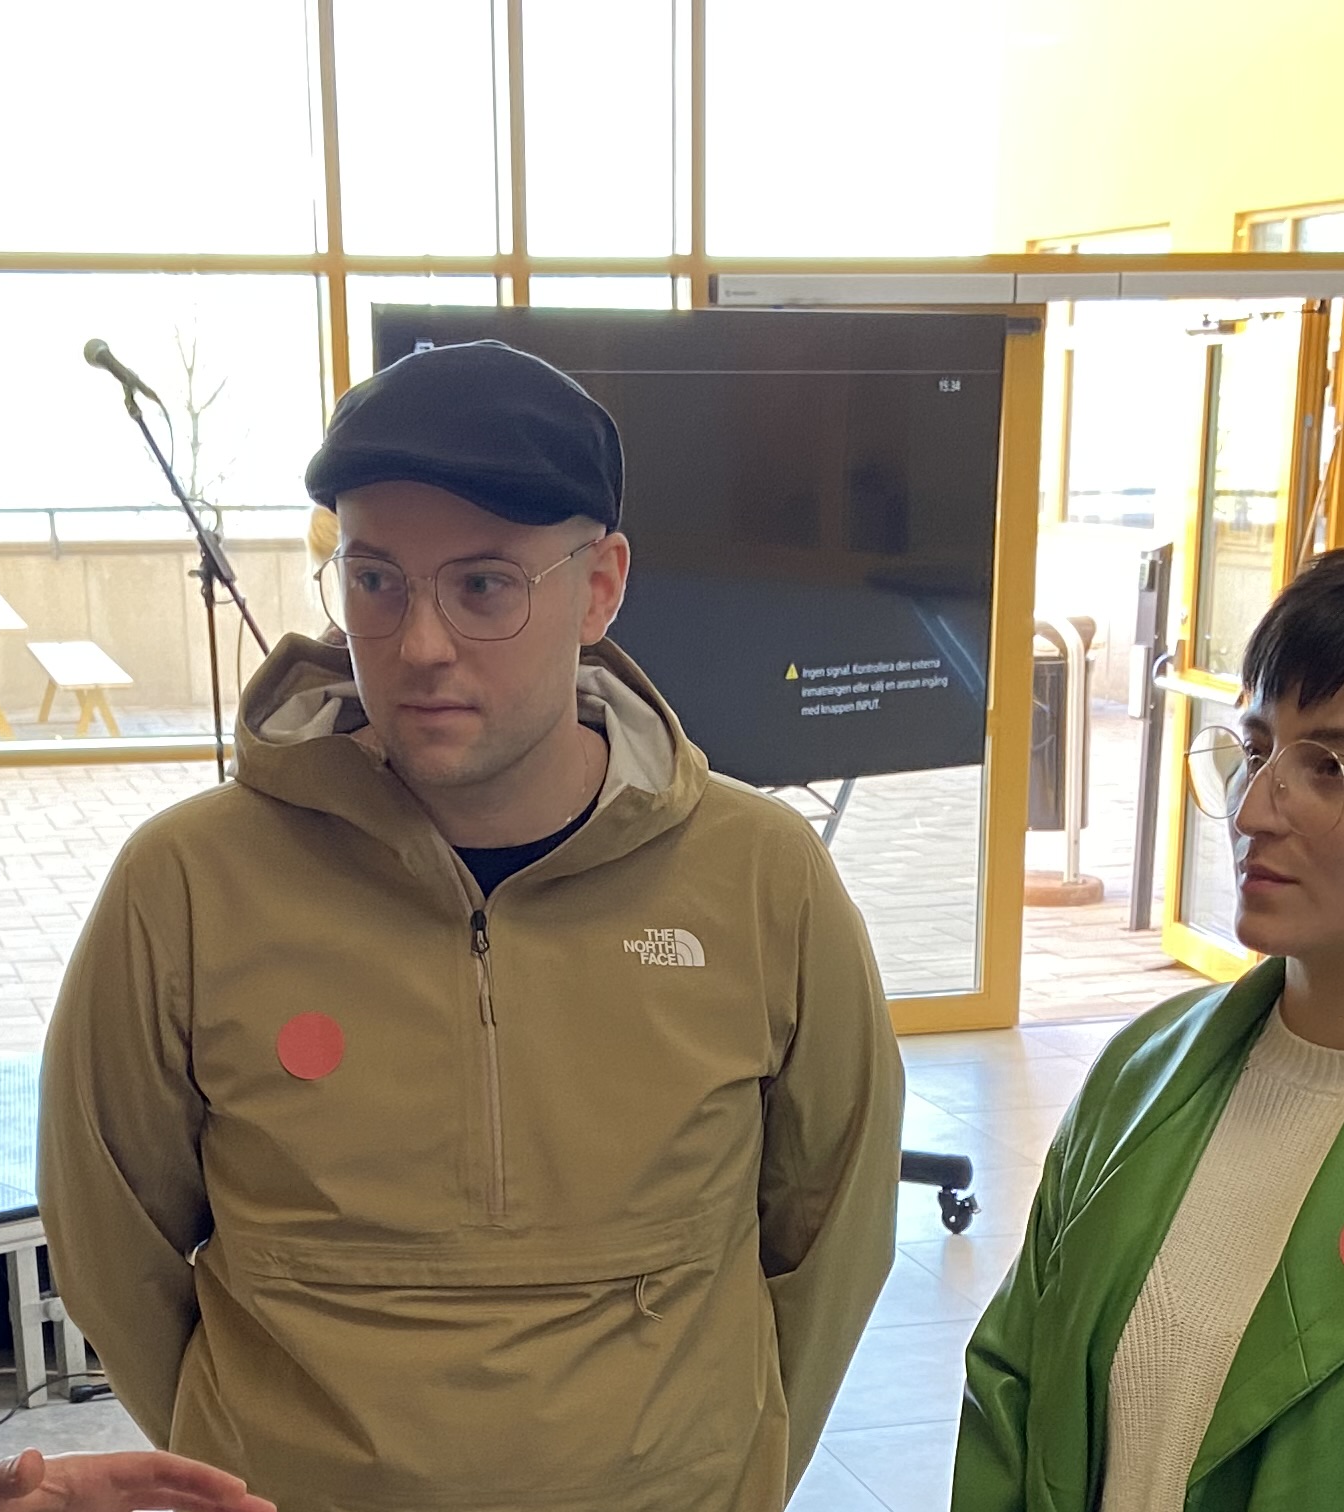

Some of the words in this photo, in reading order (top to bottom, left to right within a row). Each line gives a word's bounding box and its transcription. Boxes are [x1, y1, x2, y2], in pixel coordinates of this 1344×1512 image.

[802, 668, 825, 680] Ingen
[852, 662, 894, 674] Kontrollera
[896, 660, 911, 671] den
[912, 659, 940, 670] externa
[853, 682, 869, 693] eller
[885, 681, 895, 690] en
[801, 704, 820, 715] med
[821, 703, 854, 715] knappen
[644, 928, 674, 942] THE
[623, 940, 675, 954] NORTH
[640, 953, 678, 966] FACE
